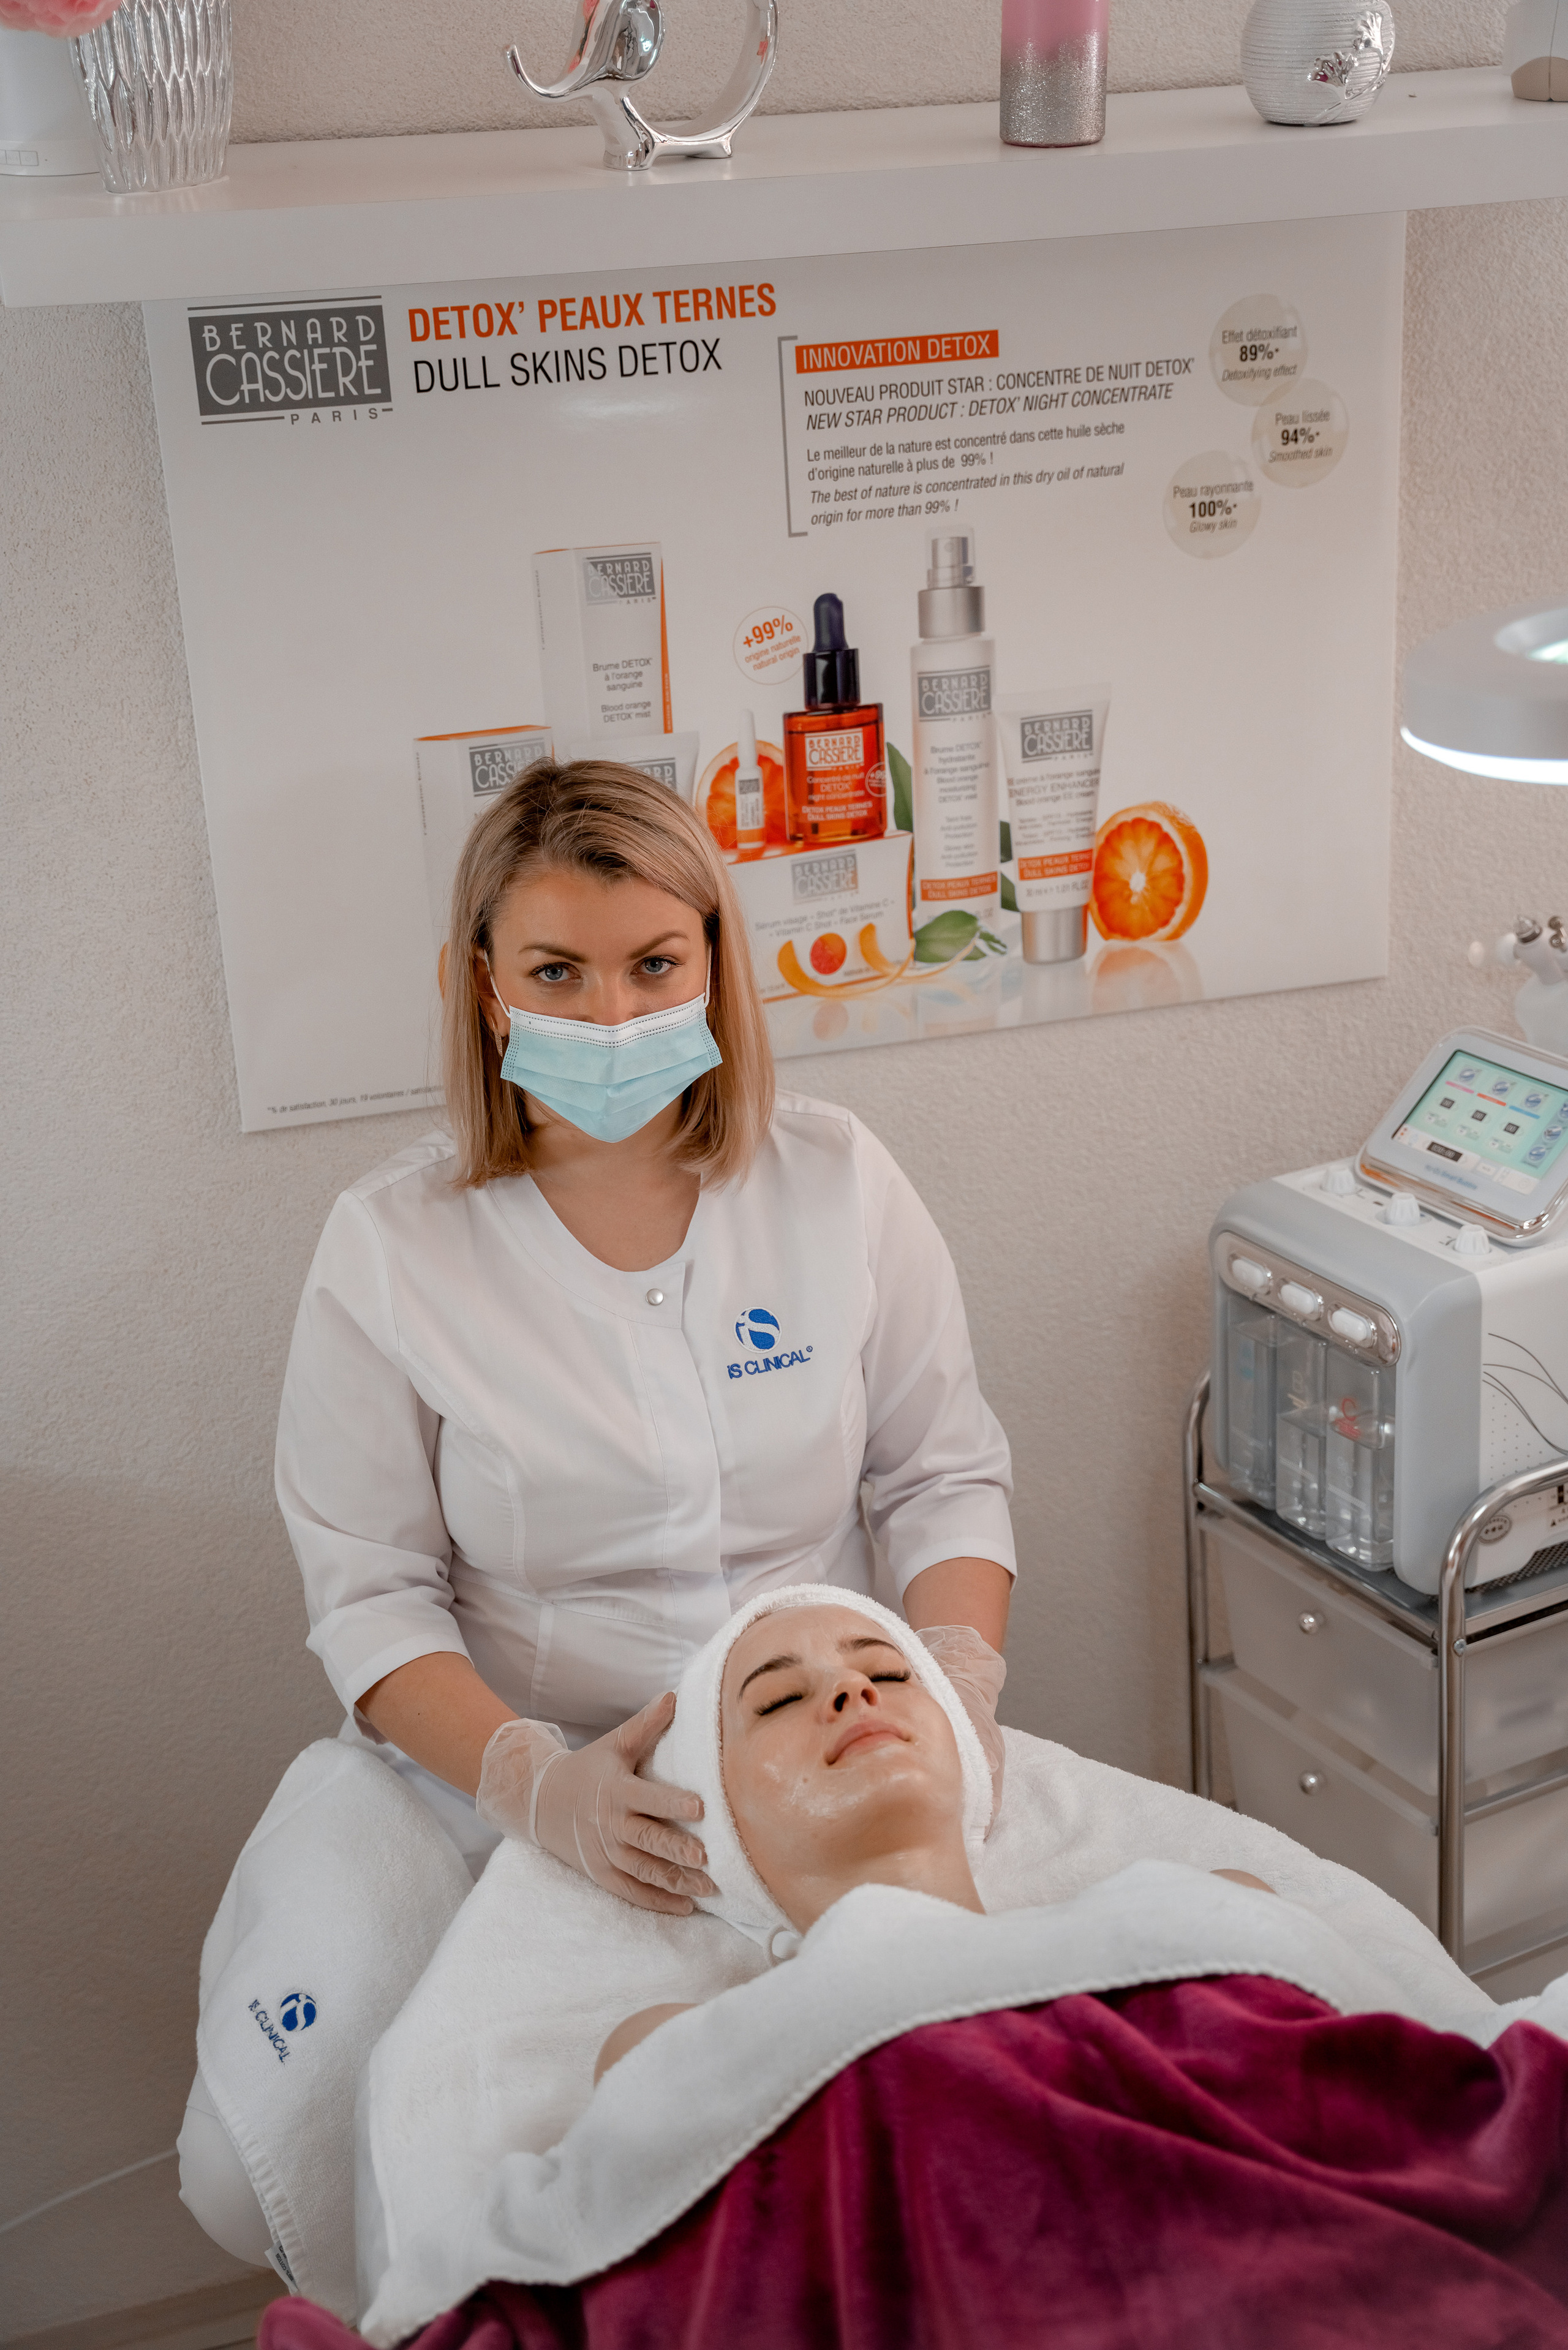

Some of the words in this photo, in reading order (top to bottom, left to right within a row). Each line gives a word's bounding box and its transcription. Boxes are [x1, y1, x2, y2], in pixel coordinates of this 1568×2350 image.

[408, 301, 524, 342] DETOX'
[538, 293, 645, 333] PEAUX
[652, 282, 776, 324] TERNES
[202, 315, 375, 352] BERNARD
[1222, 330, 1243, 344] Effet
[414, 356, 500, 393] DULL
[510, 347, 606, 386] SKINS
[619, 338, 722, 377] DETOX
[803, 339, 920, 369] INNOVATION
[927, 334, 990, 360] DETOX
[206, 344, 382, 405] CASSIERE
[804, 385, 875, 407] NOUVEAU
[880, 379, 943, 400] PRODUIT
[948, 375, 984, 394] STAR
[997, 367, 1082, 390] CONCENTRE
[1086, 365, 1104, 383] DE
[1109, 362, 1142, 381] NUIT
[1273, 364, 1298, 377] effect
[290, 408, 378, 425] PARIS
[806, 412, 842, 431] NEW
[845, 409, 883, 427] STAR
[886, 402, 958, 424] PRODUCT
[1023, 392, 1069, 412] NIGHT
[1071, 382, 1174, 408] CONCENTRATE
[1275, 412, 1300, 426] Peau
[807, 448, 821, 462] Le
[823, 445, 867, 460] meilleur
[870, 443, 883, 456] de
[886, 442, 895, 455] la
[898, 440, 932, 453] nature
[935, 437, 951, 450] est
[954, 431, 1007, 449] concentré
[1009, 431, 1036, 444] dans
[1038, 427, 1063, 442] cette
[1066, 424, 1091, 439] huile
[1094, 421, 1125, 437] sèche
[808, 464, 855, 481] d'origine
[858, 460, 904, 476] naturelle
[907, 458, 913, 472] à
[916, 458, 939, 473] plus
[941, 455, 956, 469] de
[960, 452, 986, 467] 99%
[810, 491, 831, 504] The
[834, 488, 858, 502] best
[861, 485, 873, 500] of
[874, 484, 910, 498] nature
[913, 481, 923, 495] is
[925, 475, 997, 494] concentrated
[999, 473, 1010, 486] in
[1012, 470, 1033, 486] this
[1035, 470, 1055, 486] dry
[1057, 467, 1071, 481] oil
[1072, 465, 1085, 480] of
[1086, 462, 1125, 478] natural
[1173, 485, 1198, 499] Peau
[810, 509, 843, 527] origin
[846, 508, 863, 522] for
[865, 508, 894, 519] more
[897, 503, 922, 518] than
[924, 499, 951, 516] 99%
[743, 614, 793, 648] +99%
[592, 663, 620, 672] Brume
[745, 649, 769, 663] origine
[606, 681, 643, 691] sanguine
[601, 704, 624, 712] Blood
[625, 701, 652, 710] orange
